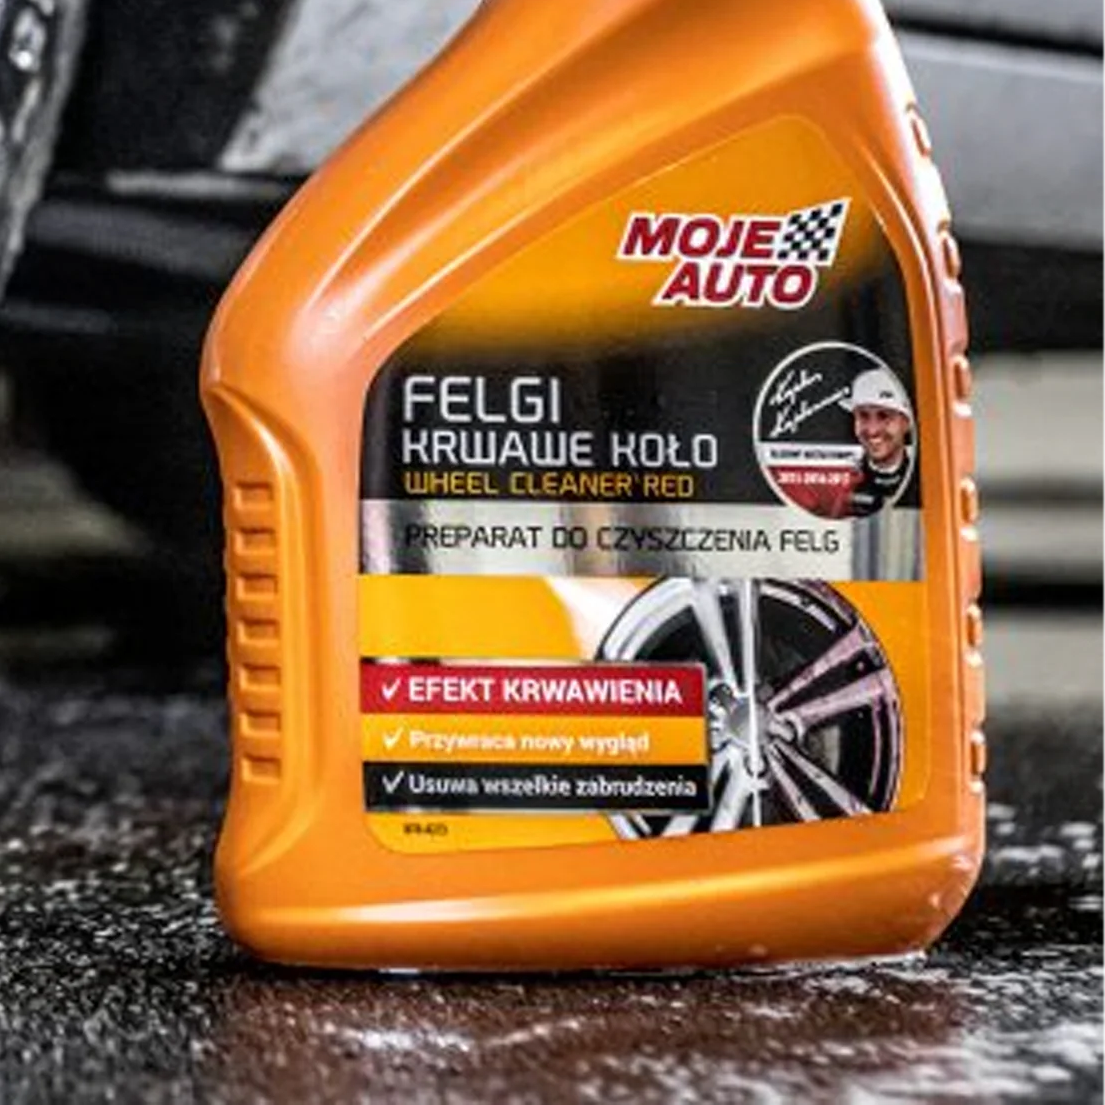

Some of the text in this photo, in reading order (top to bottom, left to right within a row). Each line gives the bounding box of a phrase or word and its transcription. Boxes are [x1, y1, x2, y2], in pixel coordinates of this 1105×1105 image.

[622, 214, 781, 261] MOJE
[661, 262, 814, 306] AUTO
[403, 375, 560, 424] FELGI
[403, 430, 718, 469] KRWAWE KOŁO
[404, 471, 695, 498] WHEEL CLEANER RED
[405, 526, 840, 554] PREPARAT DO CZYSZCZENIA FELG
[408, 678, 682, 705] EFEKT KRWAWIENIA
[409, 731, 650, 757] Przywraca nowy wygląd
[408, 774, 697, 797] Usuwa wszelkie zabrudzenia
